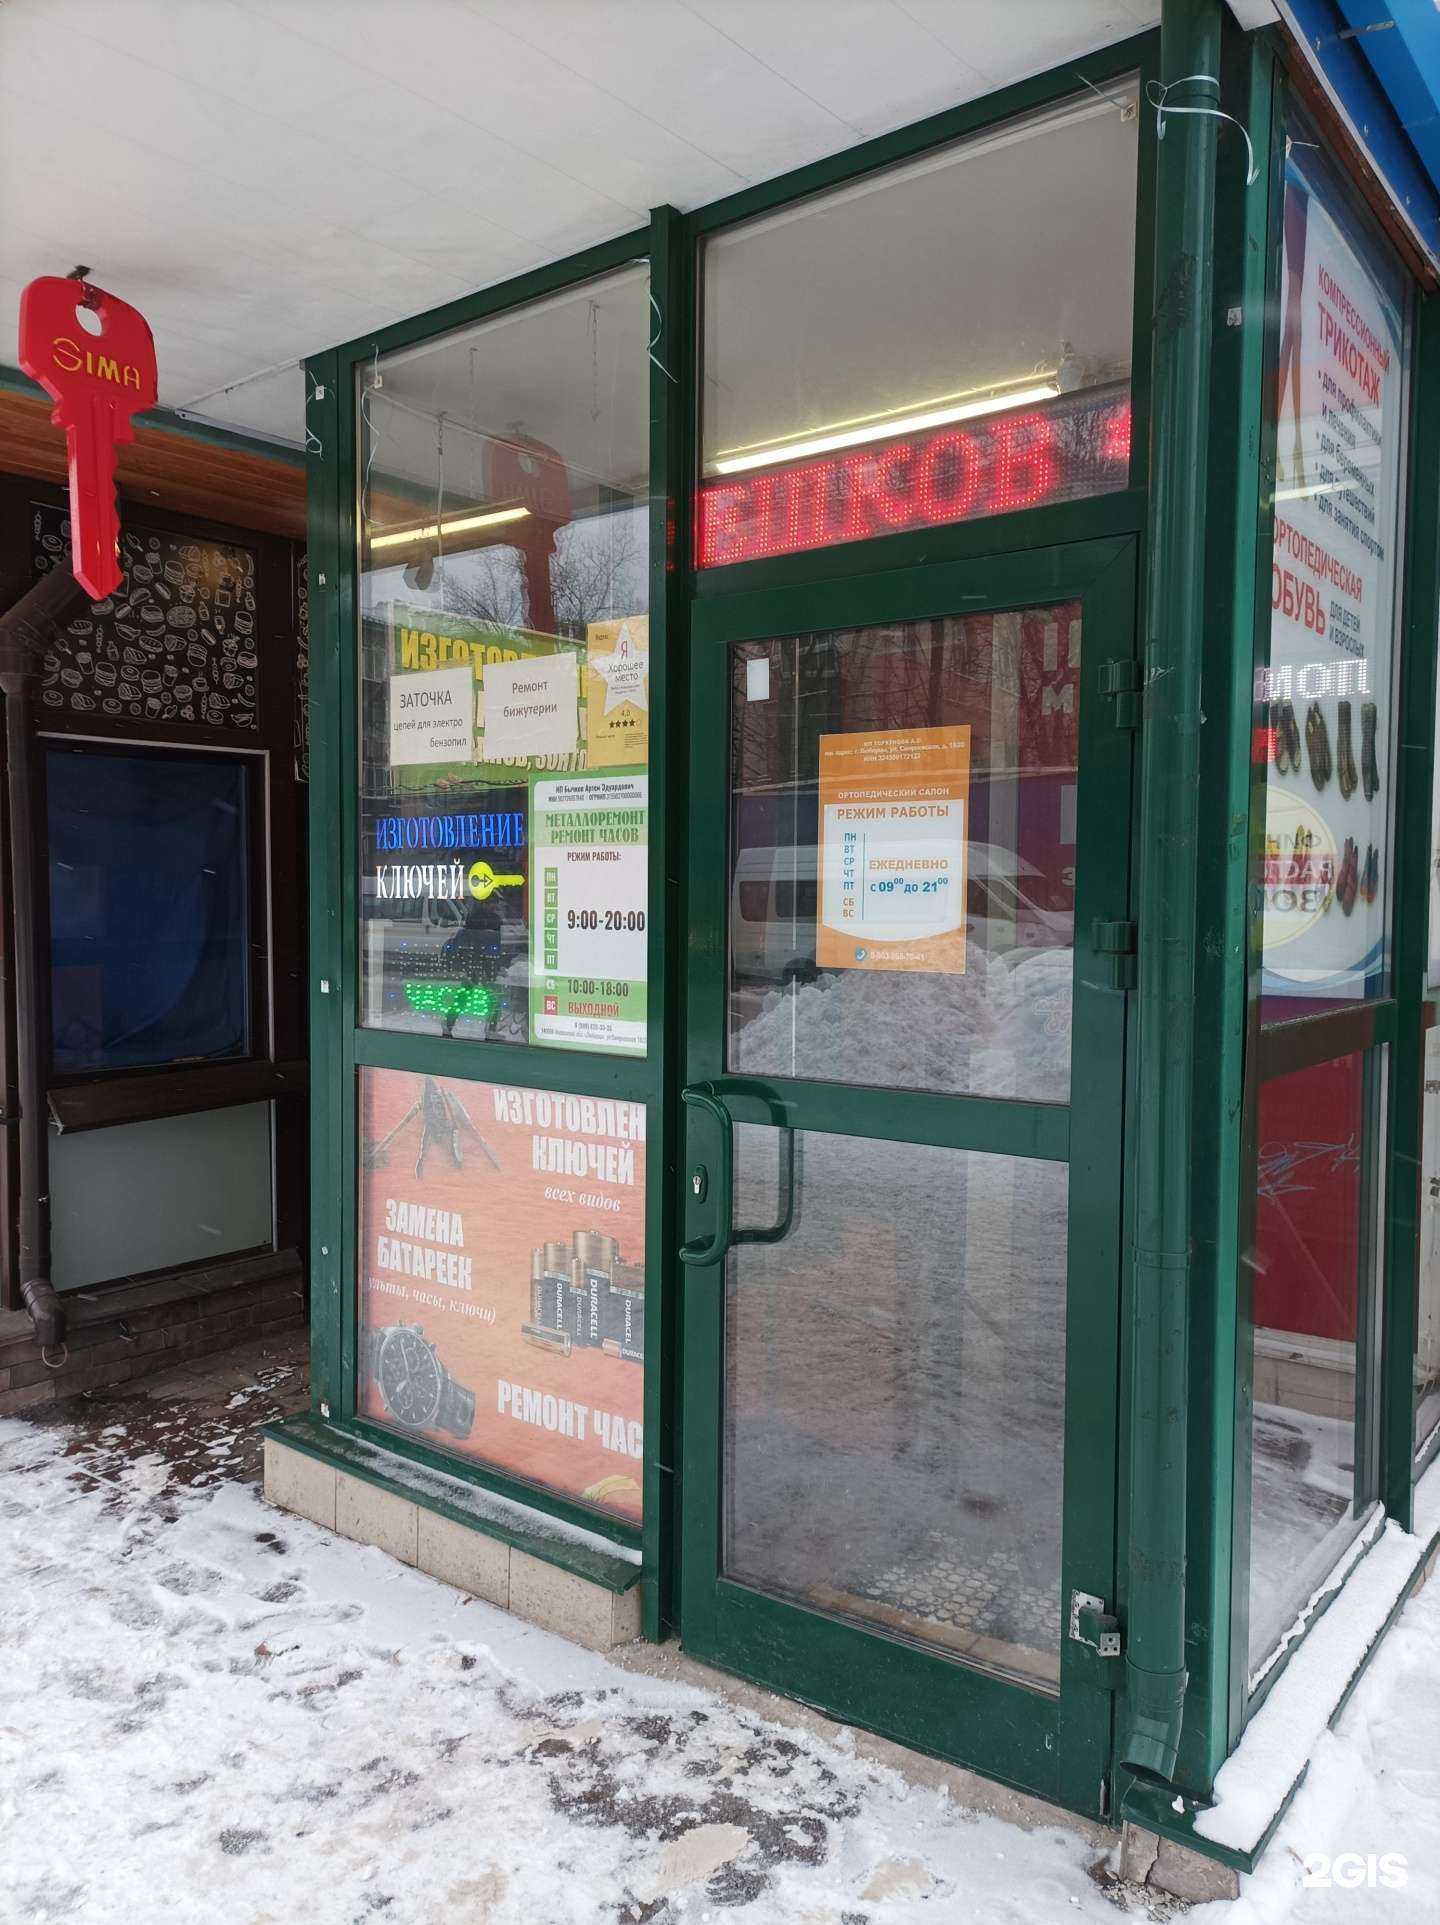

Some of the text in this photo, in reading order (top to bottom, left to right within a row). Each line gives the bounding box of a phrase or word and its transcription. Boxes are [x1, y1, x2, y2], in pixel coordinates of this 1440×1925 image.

[1318, 264, 1390, 377] КОМПРЕССИОННЫЙ
[1318, 301, 1380, 408] ТРИКОТАЖ
[53, 338, 140, 390] SIMA
[1322, 373, 1337, 399] для
[1320, 434, 1335, 459] для
[1318, 495, 1332, 520] для
[608, 660, 644, 673] Хорошее
[615, 672, 639, 682] место
[512, 682, 548, 694] Ремонт
[400, 690, 452, 708] ЗАТОЧКА
[503, 704, 558, 718] бижутерии
[394, 718, 463, 731] цепей для электро
[430, 737, 467, 747] бензопил
[838, 788, 950, 799] ОРТОПЕДИЧЕСКИЙ САЛОН
[545, 810, 646, 828] МЕТАЛЛОРЕМОНТ
[837, 805, 949, 820] РЕЖИМ РАБОТЫ
[376, 813, 524, 849] ИЗГОТОВЛЕНИЕ
[551, 828, 640, 844] РЕМОНТ ЧАСОВ
[844, 833, 857, 842] ПН
[567, 850, 622, 862] РЕЖИМ РАБОТЫ:
[844, 845, 855, 854] ВТ
[844, 857, 855, 866] СР
[869, 859, 949, 872] ЕЖЕДНЕВНО
[376, 857, 464, 900] КЛЮЧЕЙ
[843, 869, 855, 878] ЧТ
[843, 882, 855, 891] ПТ
[904, 883, 919, 894] до
[843, 898, 855, 907] СБ
[568, 909, 645, 931] 9:00-20:00
[842, 909, 854, 918] ВС
[568, 979, 629, 997] 10:00-18:00
[546, 1000, 619, 1018] ВС ВЫХОДНОЙ
[532, 1135, 634, 1186] КЛЮЧЕЙ
[544, 1186, 621, 1212] всех видов
[385, 1198, 464, 1247] ЗАМЕНА
[378, 1235, 472, 1290] БАТАРЕЕК
[413, 1289, 446, 1312] часы,
[449, 1300, 496, 1324] ключи)
[590, 1278, 598, 1339] DURACELL
[498, 1379, 644, 1460] РЕМОНТ ЧАС
